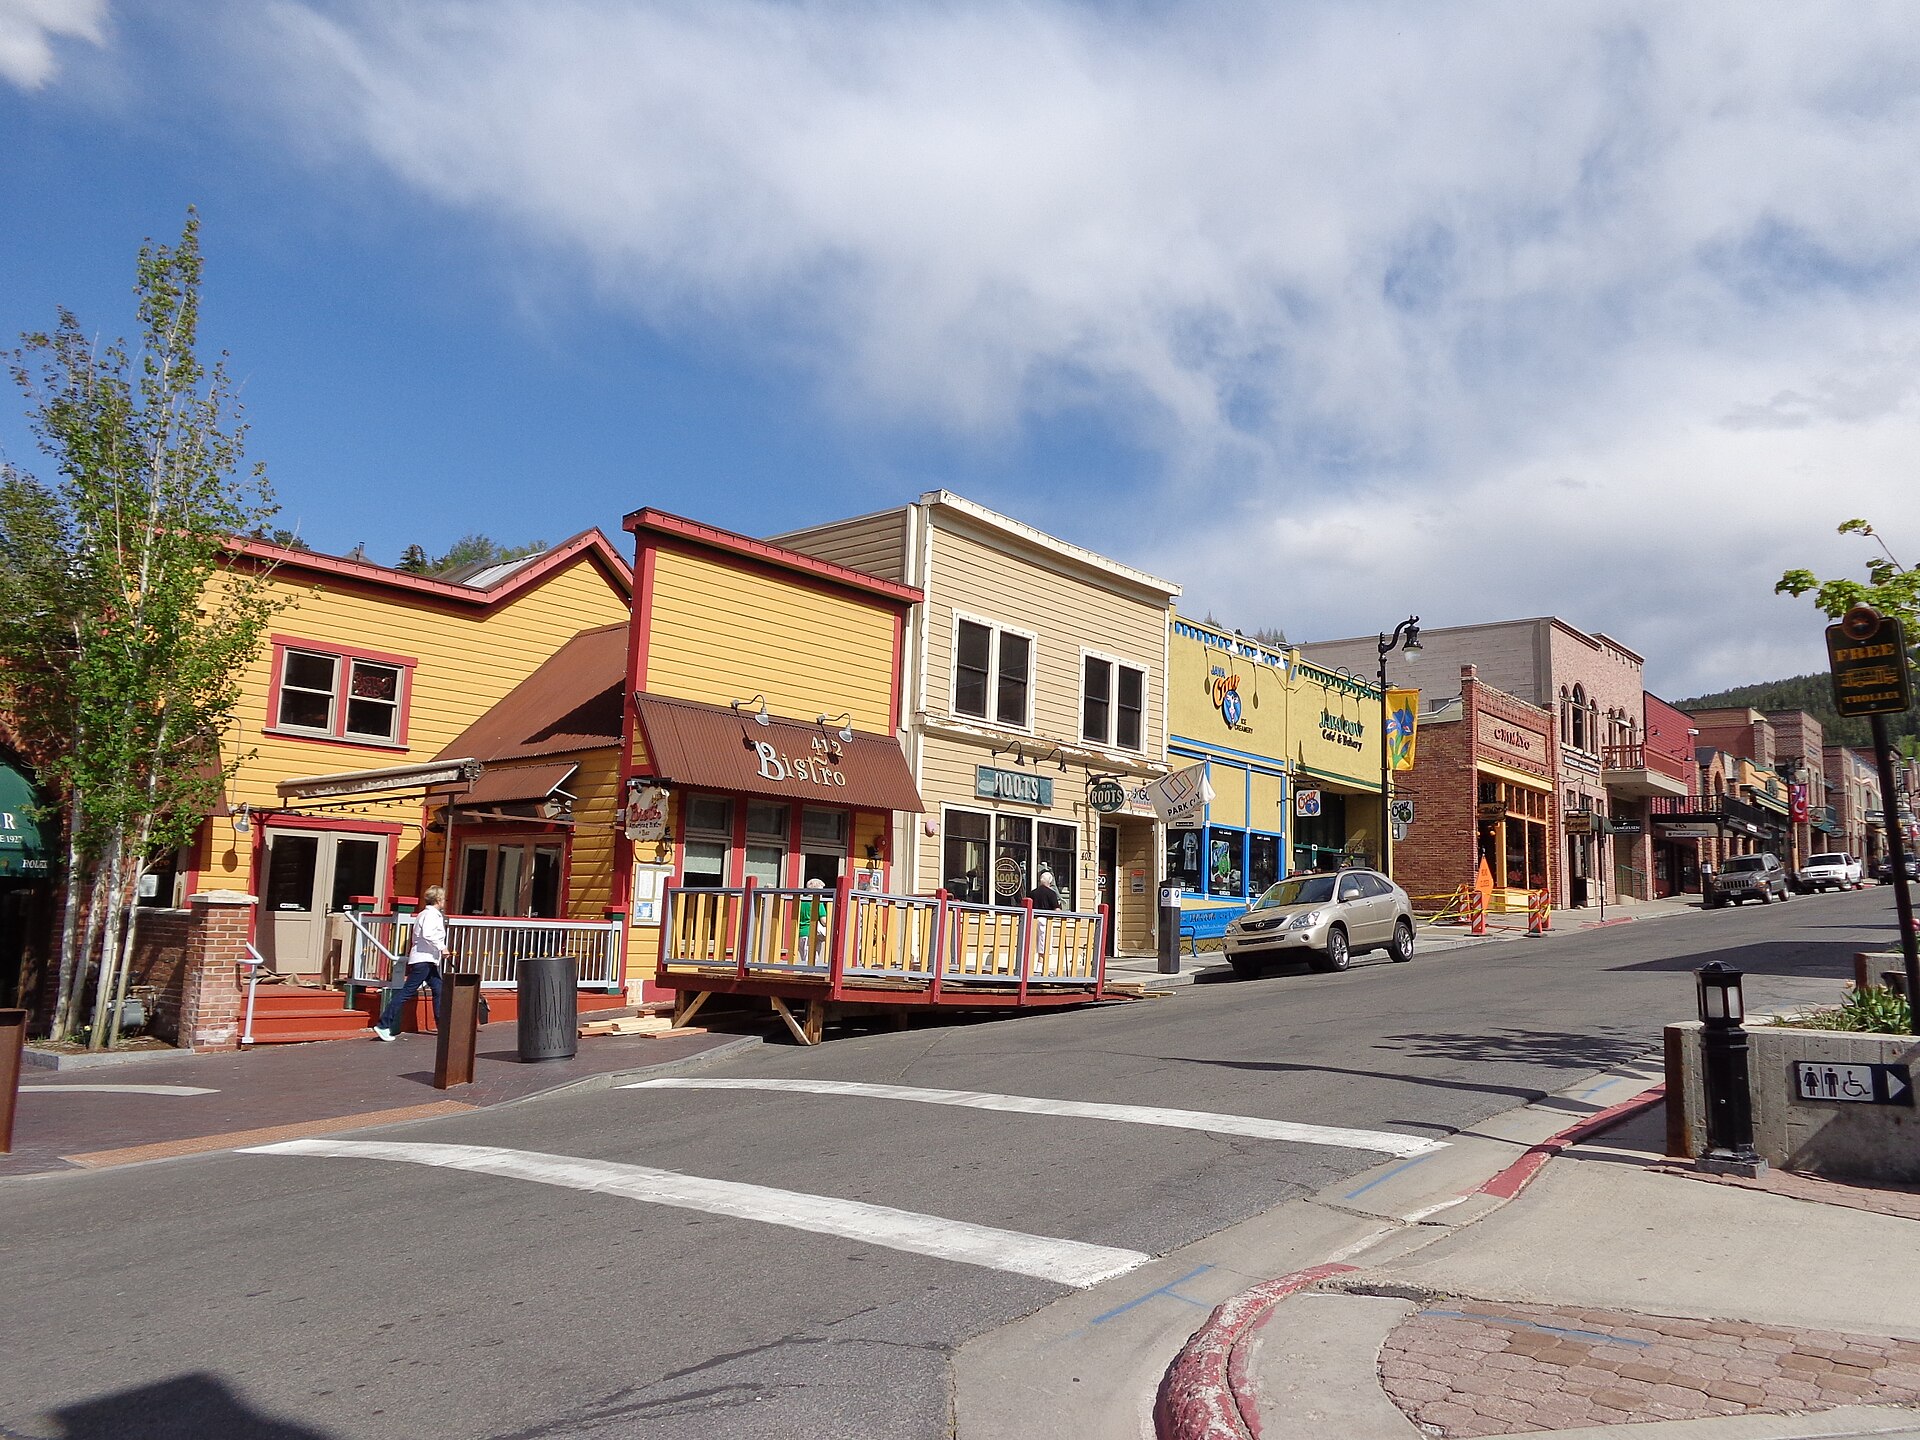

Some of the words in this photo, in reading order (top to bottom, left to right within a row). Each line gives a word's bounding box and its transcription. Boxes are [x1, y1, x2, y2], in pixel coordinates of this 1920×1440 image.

[1835, 643, 1896, 661] FREE
[811, 736, 844, 758] 412
[754, 740, 846, 787] Bistro
[994, 772, 1039, 800] ROOTS
[1091, 789, 1123, 804] ROOTS
[1167, 801, 1189, 817] PARK
